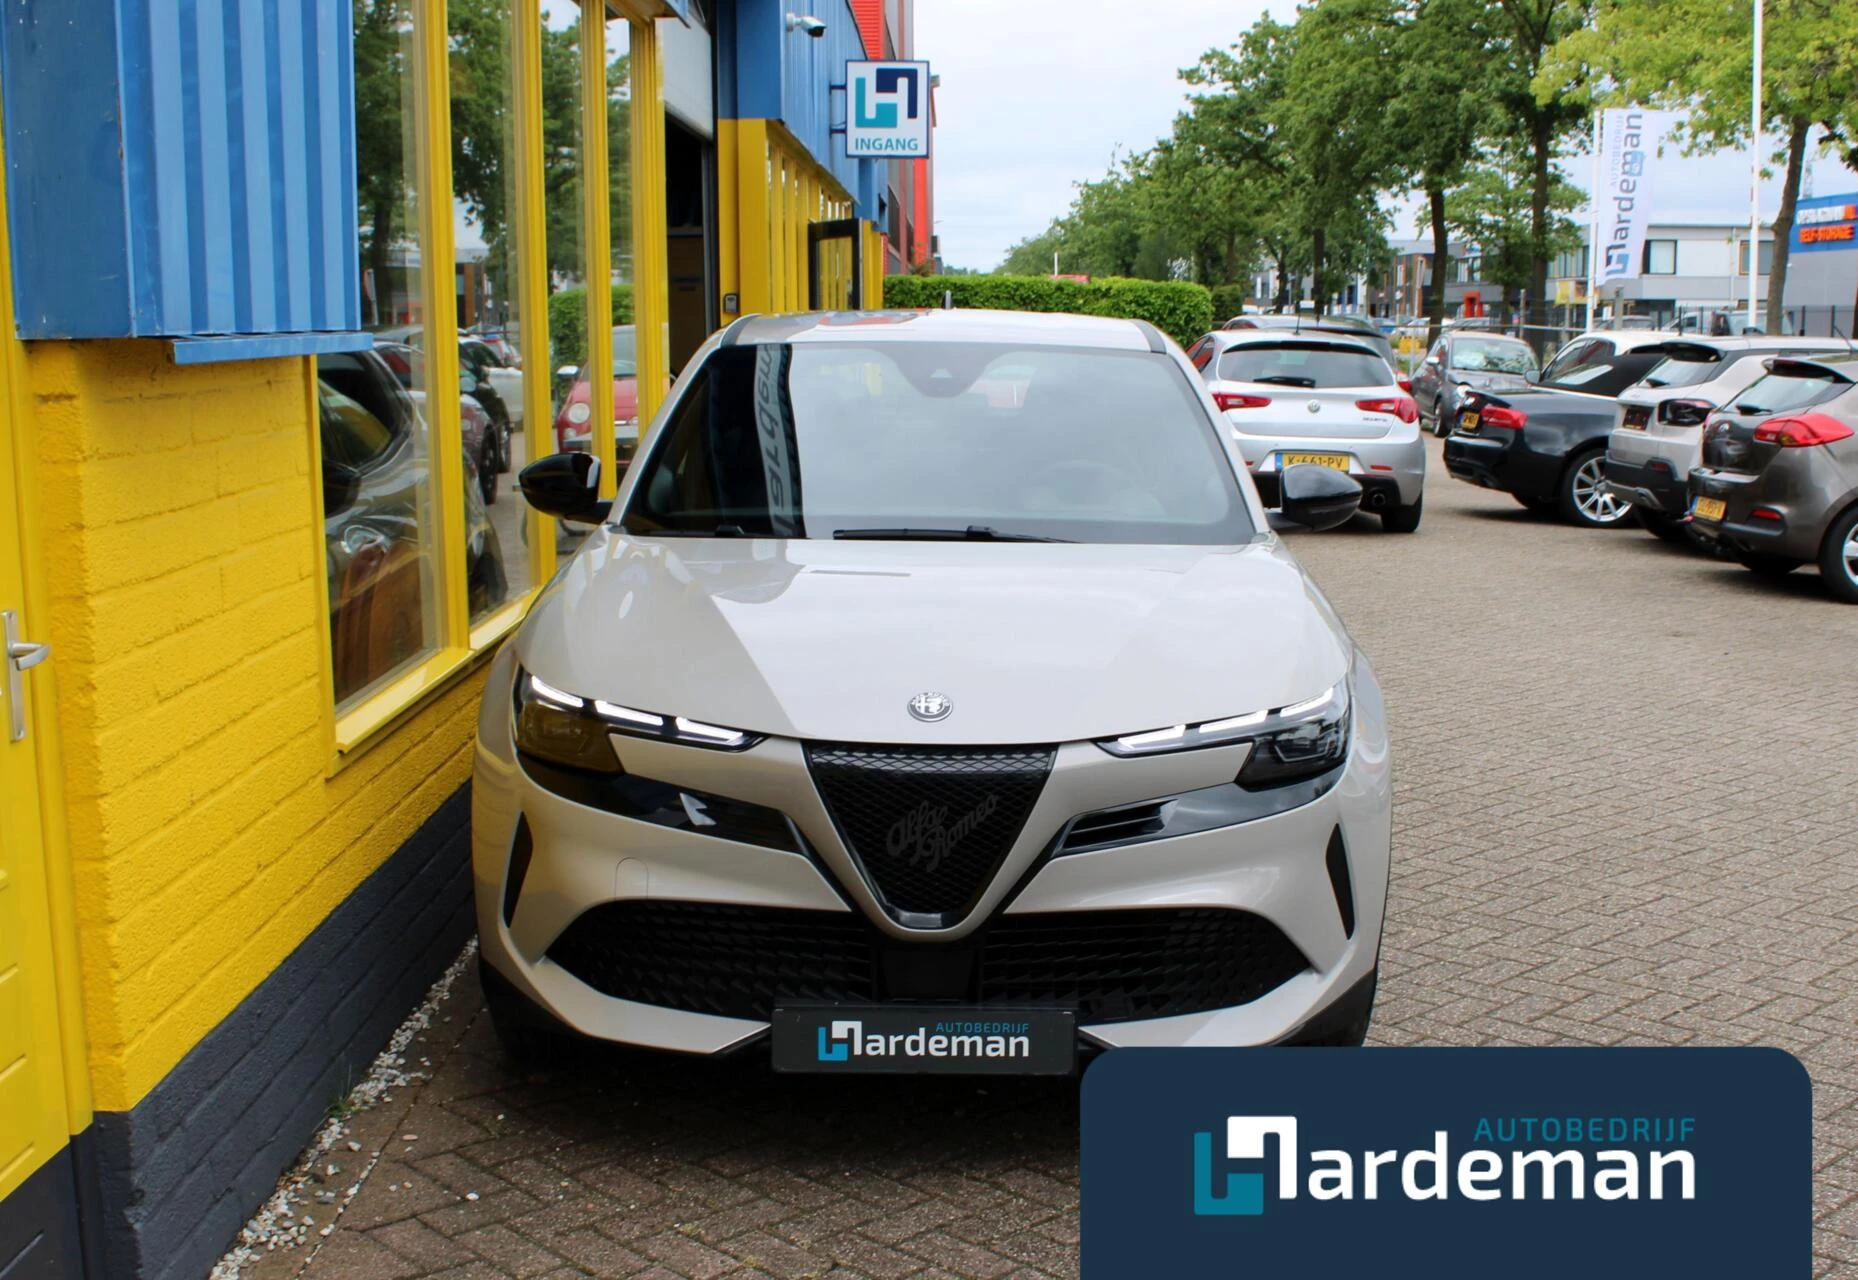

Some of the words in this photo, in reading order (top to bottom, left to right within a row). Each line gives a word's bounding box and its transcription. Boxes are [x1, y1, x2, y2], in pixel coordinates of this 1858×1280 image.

[855, 137, 919, 152] INGANG
[886, 800, 949, 866] Alfa
[920, 794, 1000, 874] Romeo
[935, 1022, 1030, 1034] AUTOBEDRIJF
